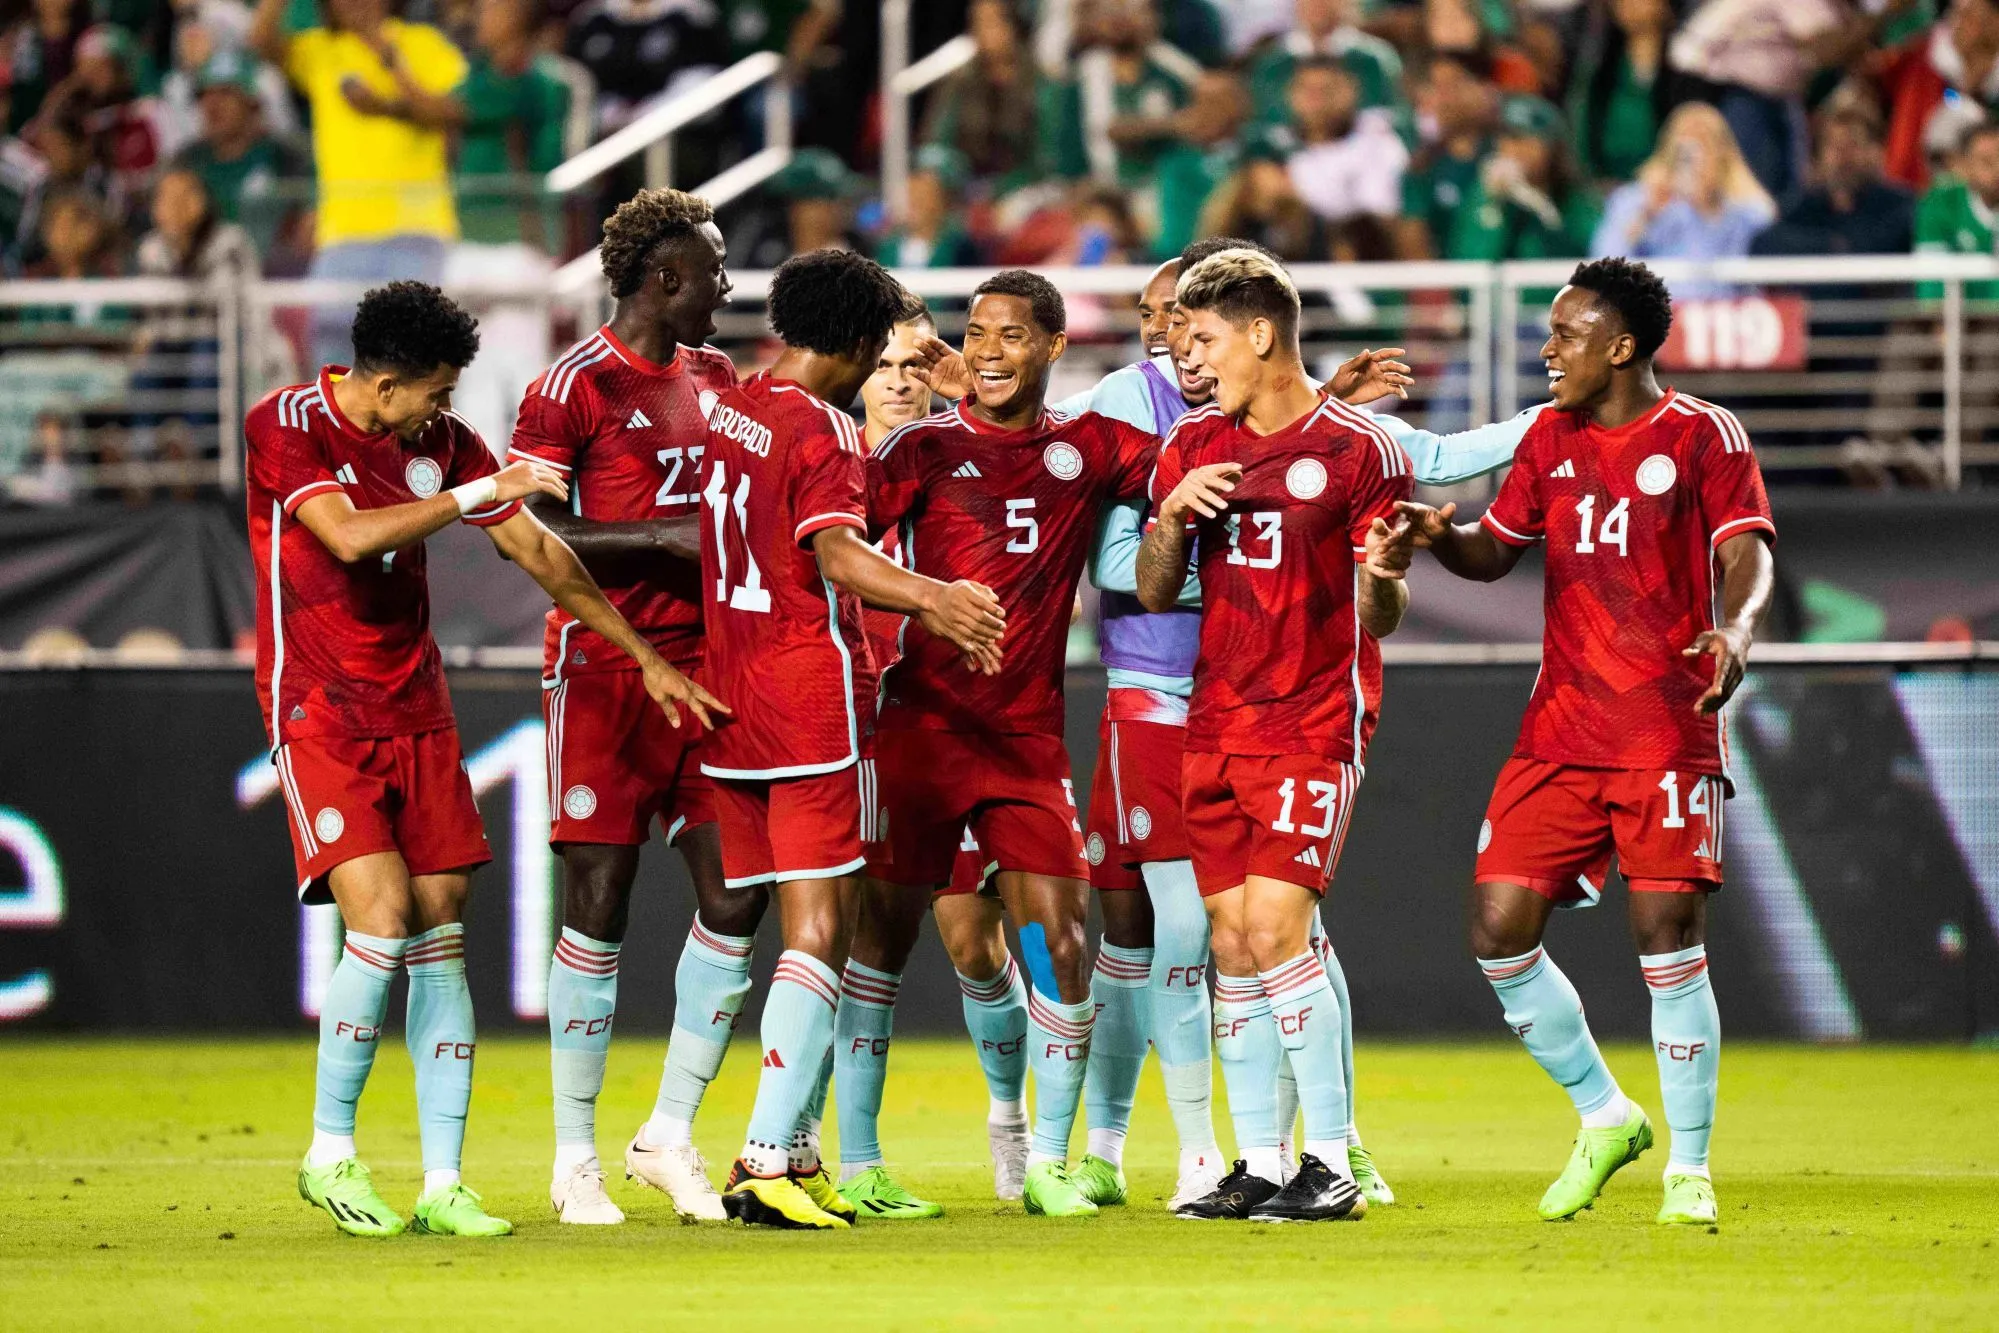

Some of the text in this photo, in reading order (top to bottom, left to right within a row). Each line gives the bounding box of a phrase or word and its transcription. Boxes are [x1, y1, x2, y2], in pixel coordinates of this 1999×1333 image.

[709, 403, 773, 458] UADRADO
[703, 460, 772, 613] 11
[1006, 498, 1039, 553] 5
[1224, 511, 1282, 570] 13
[1575, 494, 1631, 557] 14
[1271, 777, 1338, 839] 13
[1658, 770, 1711, 828] 14
[1166, 963, 1207, 987] FCF
[564, 1013, 613, 1036] FCF
[711, 1010, 742, 1031] FC
[982, 1032, 1027, 1056] FCF
[1215, 1017, 1250, 1039] CF
[1658, 1041, 1706, 1062] FCF
